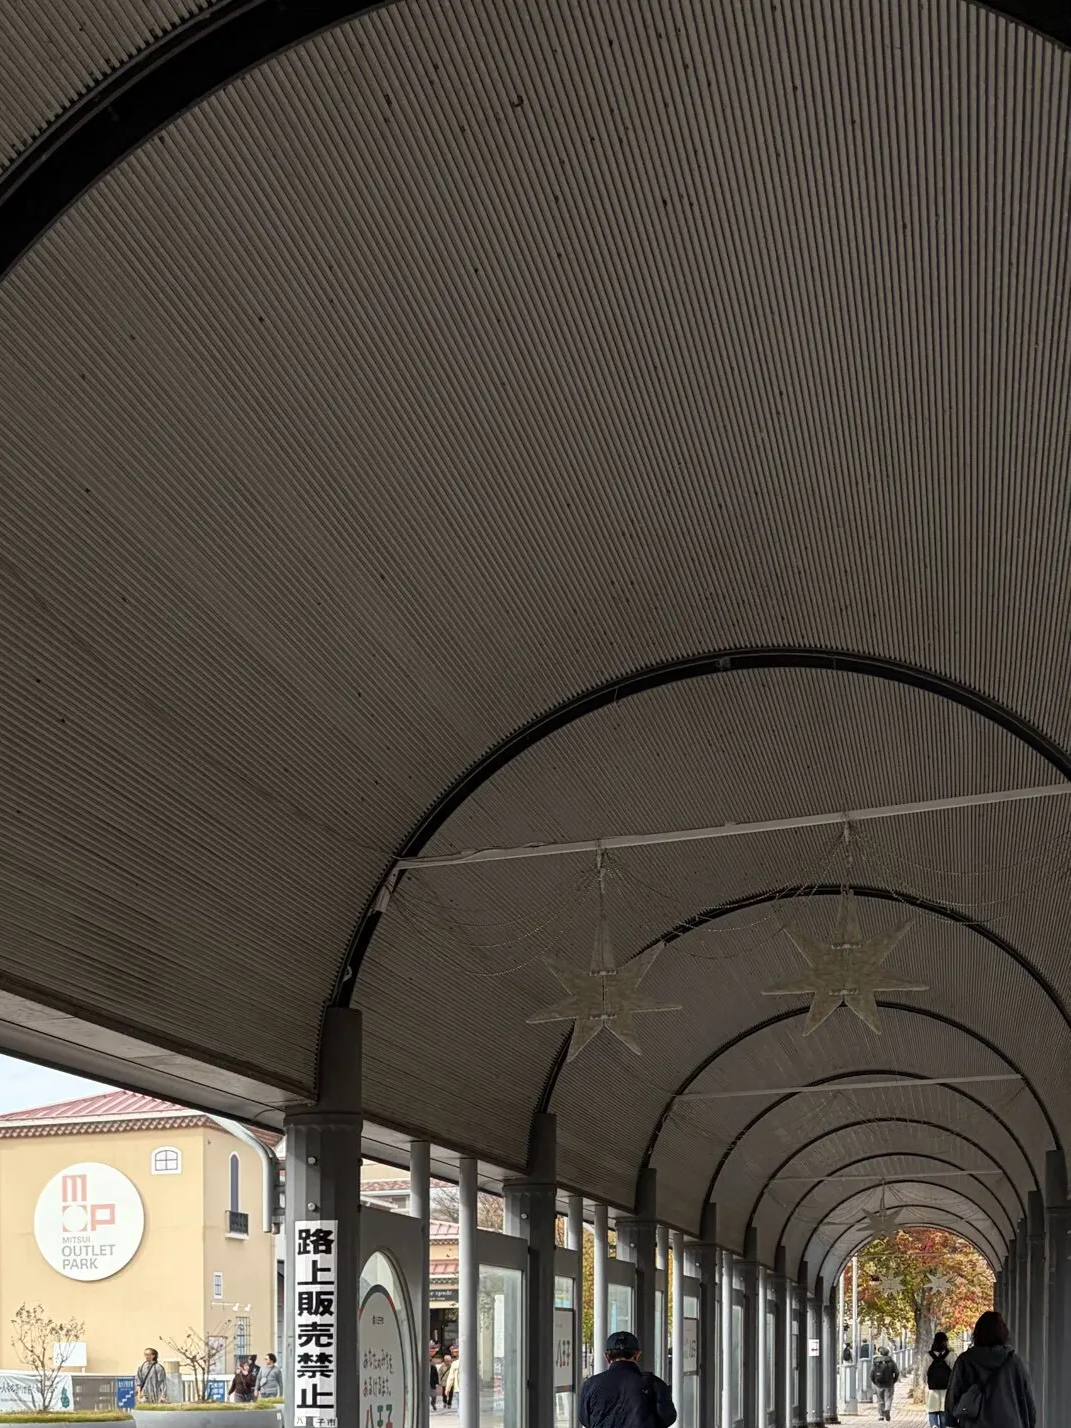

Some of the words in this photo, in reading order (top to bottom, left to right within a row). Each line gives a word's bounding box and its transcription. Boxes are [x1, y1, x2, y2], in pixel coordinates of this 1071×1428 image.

[62, 1236, 91, 1244] MITSUI
[61, 1244, 116, 1257] OUTLET
[62, 1258, 99, 1270] PARK
[297, 1228, 335, 1410] 路上販売禁止
